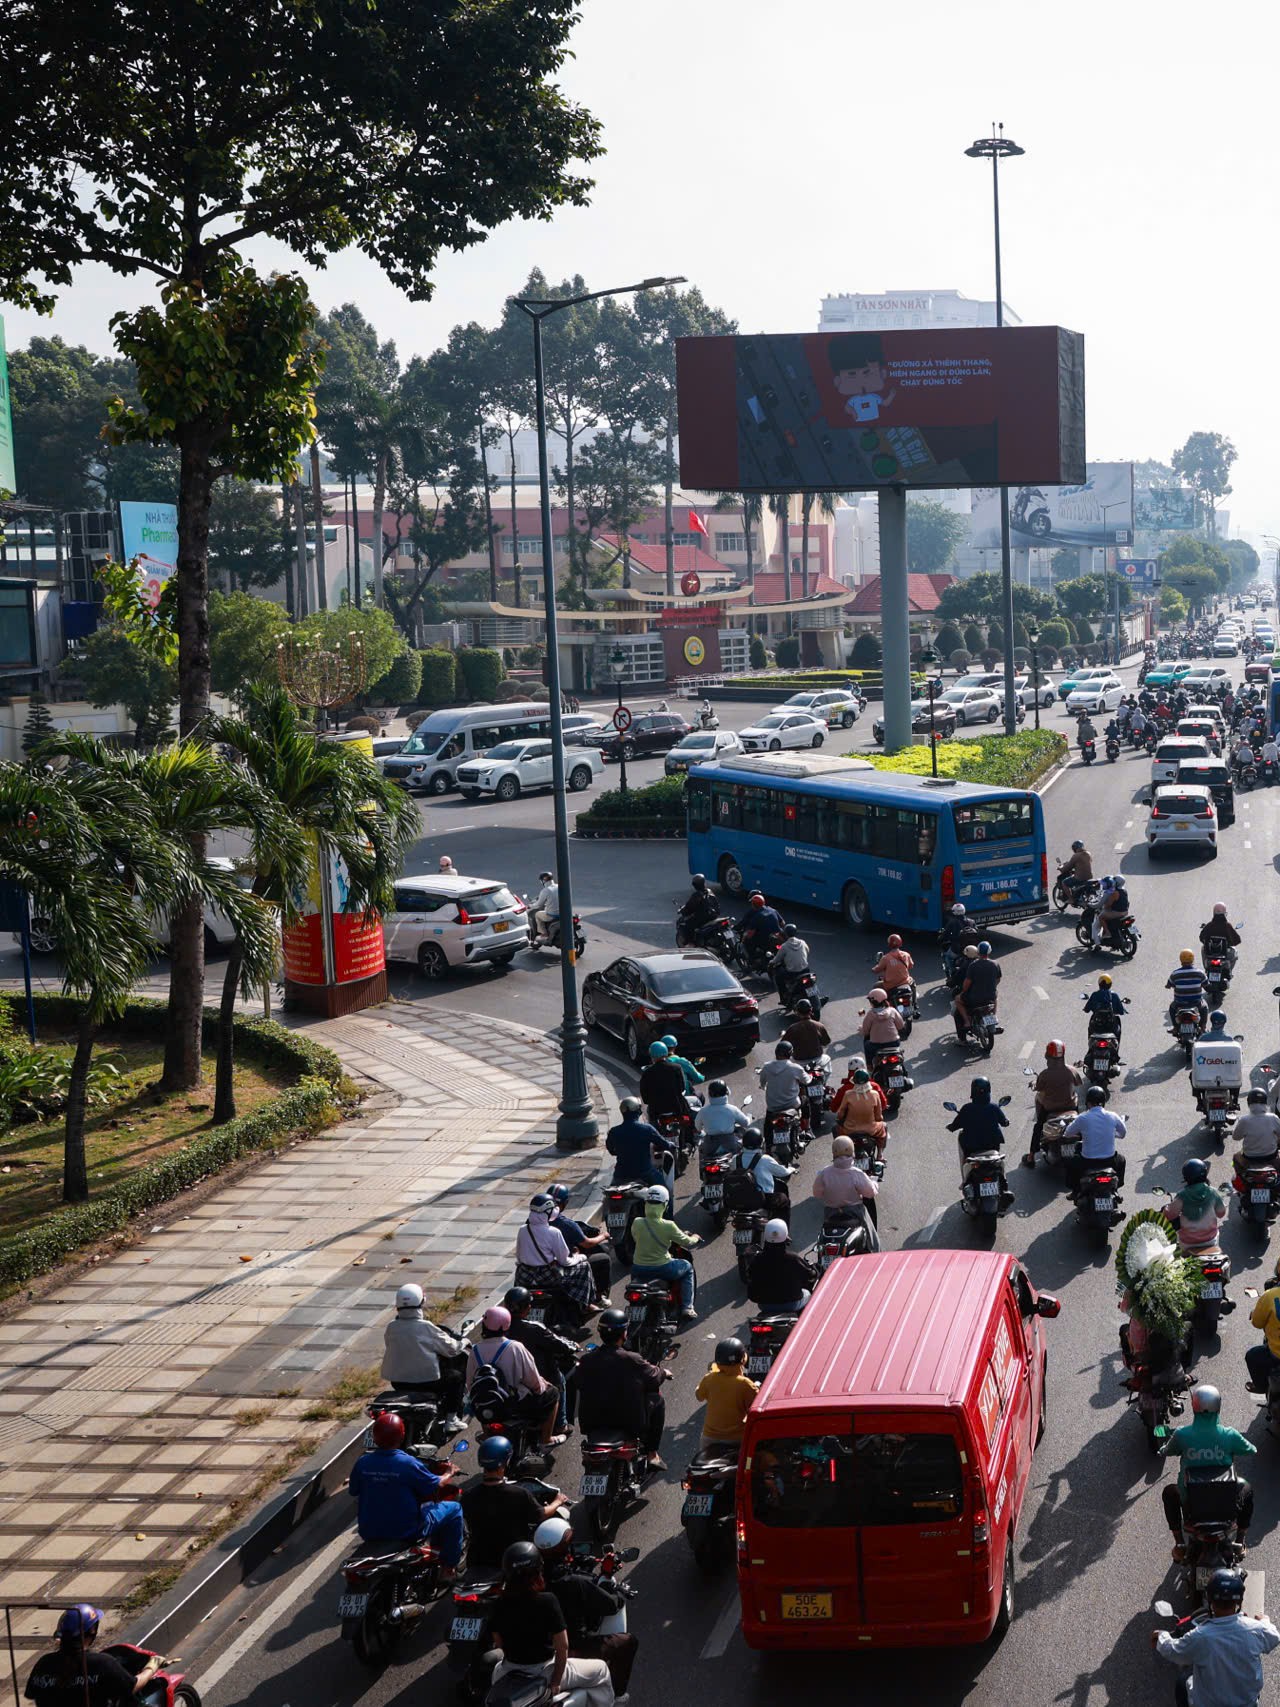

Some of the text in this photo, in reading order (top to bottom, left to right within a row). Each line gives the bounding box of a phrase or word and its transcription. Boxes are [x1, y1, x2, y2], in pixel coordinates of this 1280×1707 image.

[145, 509, 160, 524] NHÀ
[1187, 1444, 1225, 1460] Grab
[795, 1596, 817, 1606] 50E
[338, 1605, 365, 1615] 102.75
[787, 1606, 827, 1617] 463.24
[455, 1617, 477, 1628] 49-B1
